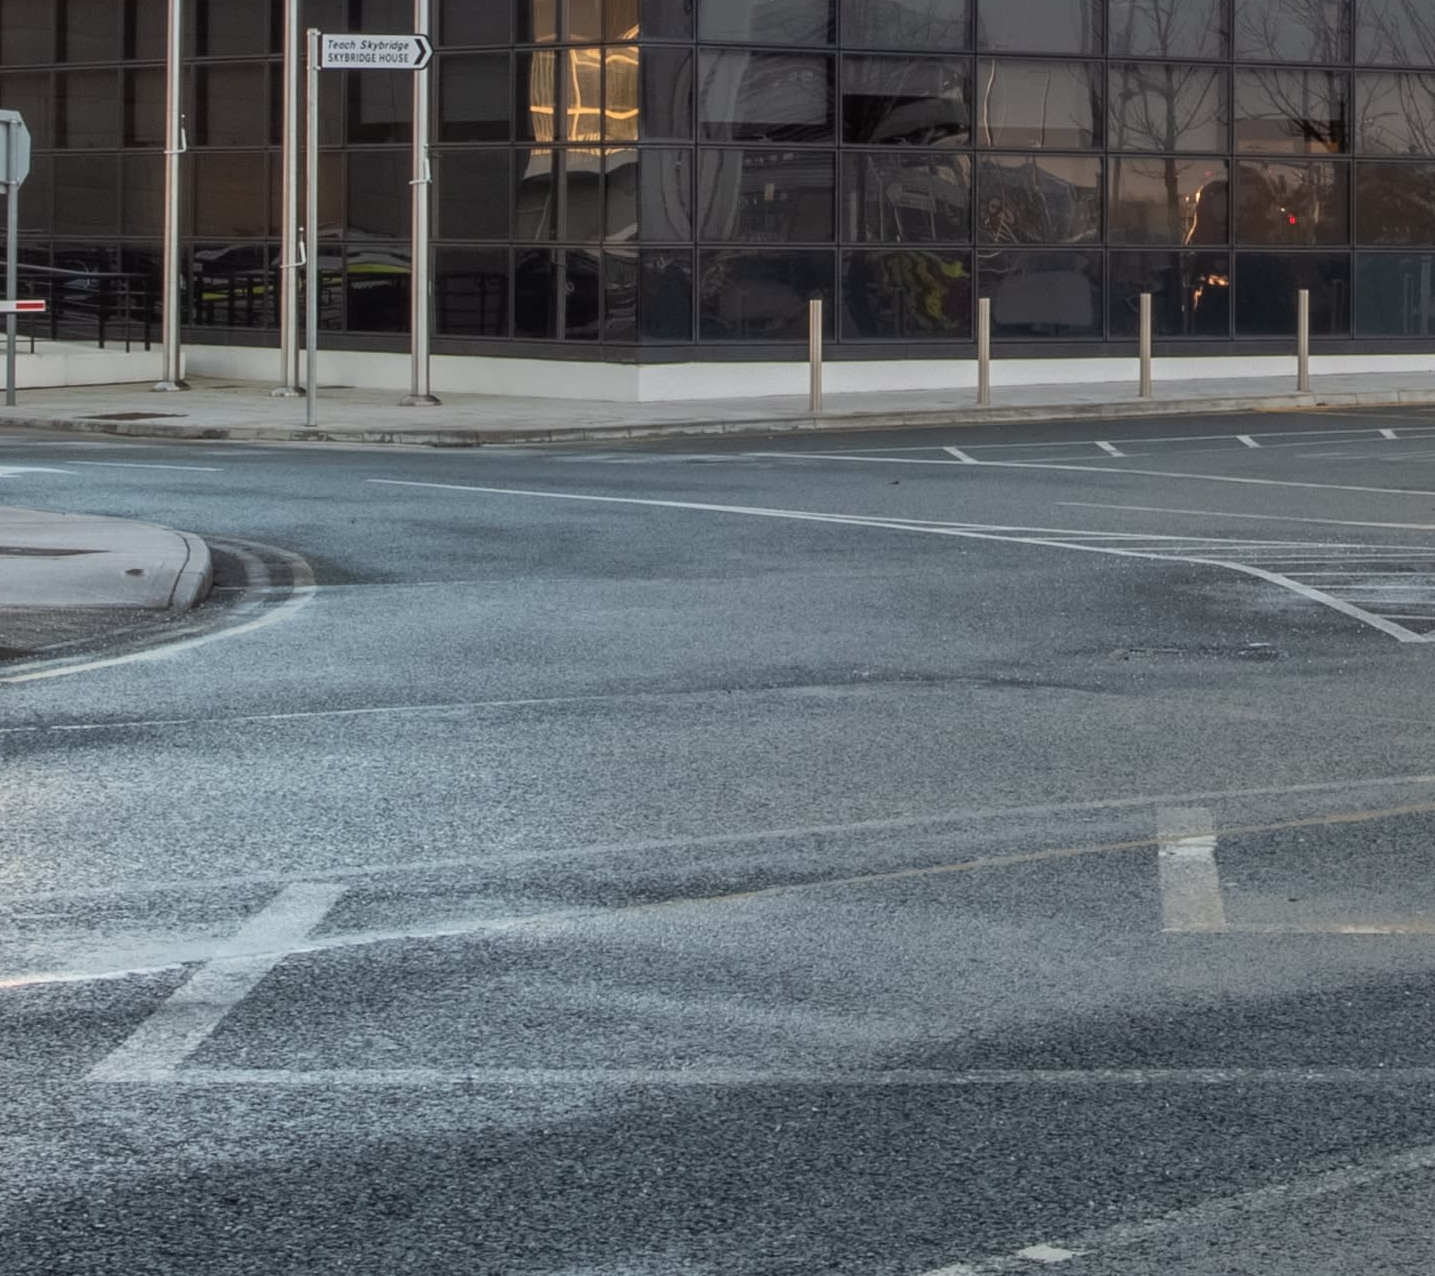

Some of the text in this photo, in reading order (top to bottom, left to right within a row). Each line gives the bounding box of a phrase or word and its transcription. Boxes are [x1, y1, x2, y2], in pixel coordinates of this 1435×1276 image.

[328, 39, 410, 52] Teach Skybridge
[328, 52, 409, 63] SKYBRIDGE HOUSE
